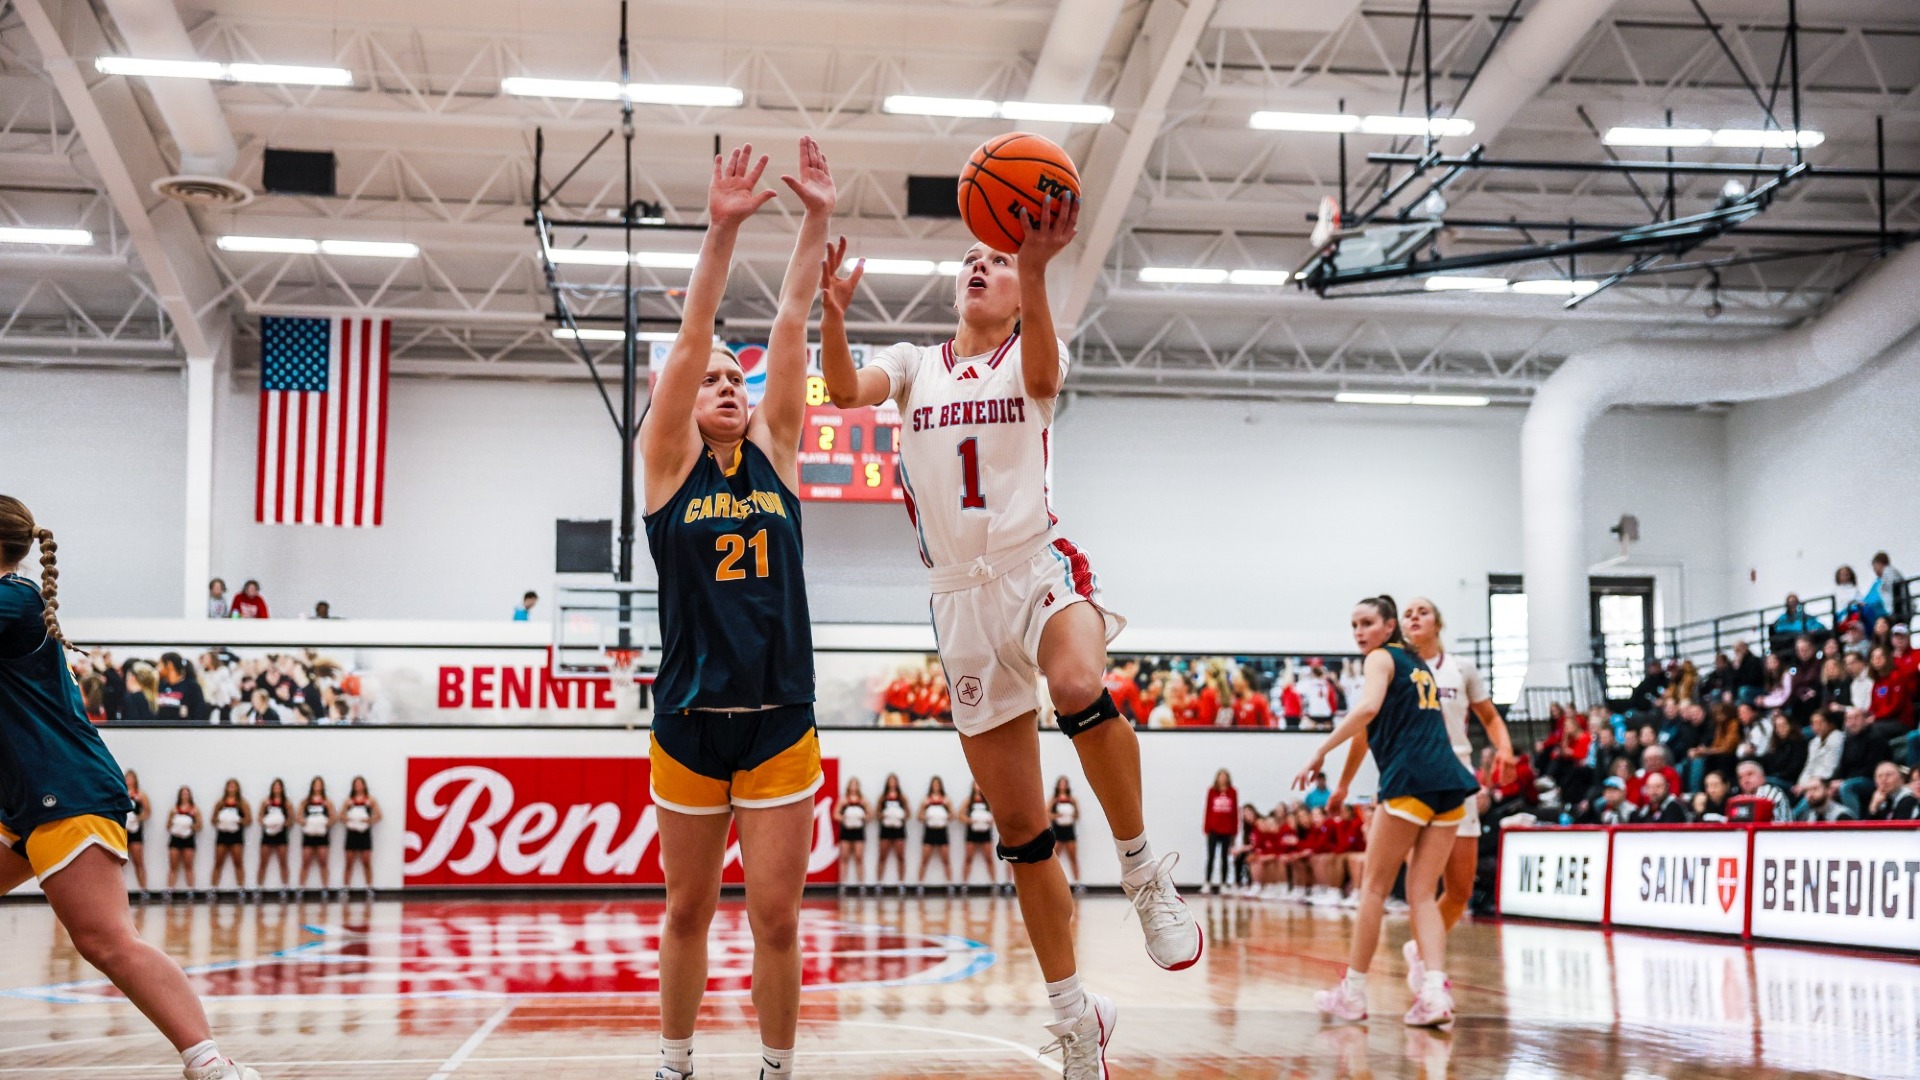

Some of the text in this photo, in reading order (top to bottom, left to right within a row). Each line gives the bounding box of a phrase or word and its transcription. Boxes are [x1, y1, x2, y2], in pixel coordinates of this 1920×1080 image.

[913, 406, 935, 432] ST.
[939, 397, 1026, 428] BENEDICT
[818, 426, 835, 451] 2
[864, 463, 881, 488] 5
[956, 436, 986, 511] 1
[715, 528, 769, 582] 21
[438, 666, 616, 709] BENNIE
[1519, 855, 1589, 896] WE ARE
[1640, 856, 1711, 906] SAINT
[1762, 858, 1920, 920] BENEDICT
